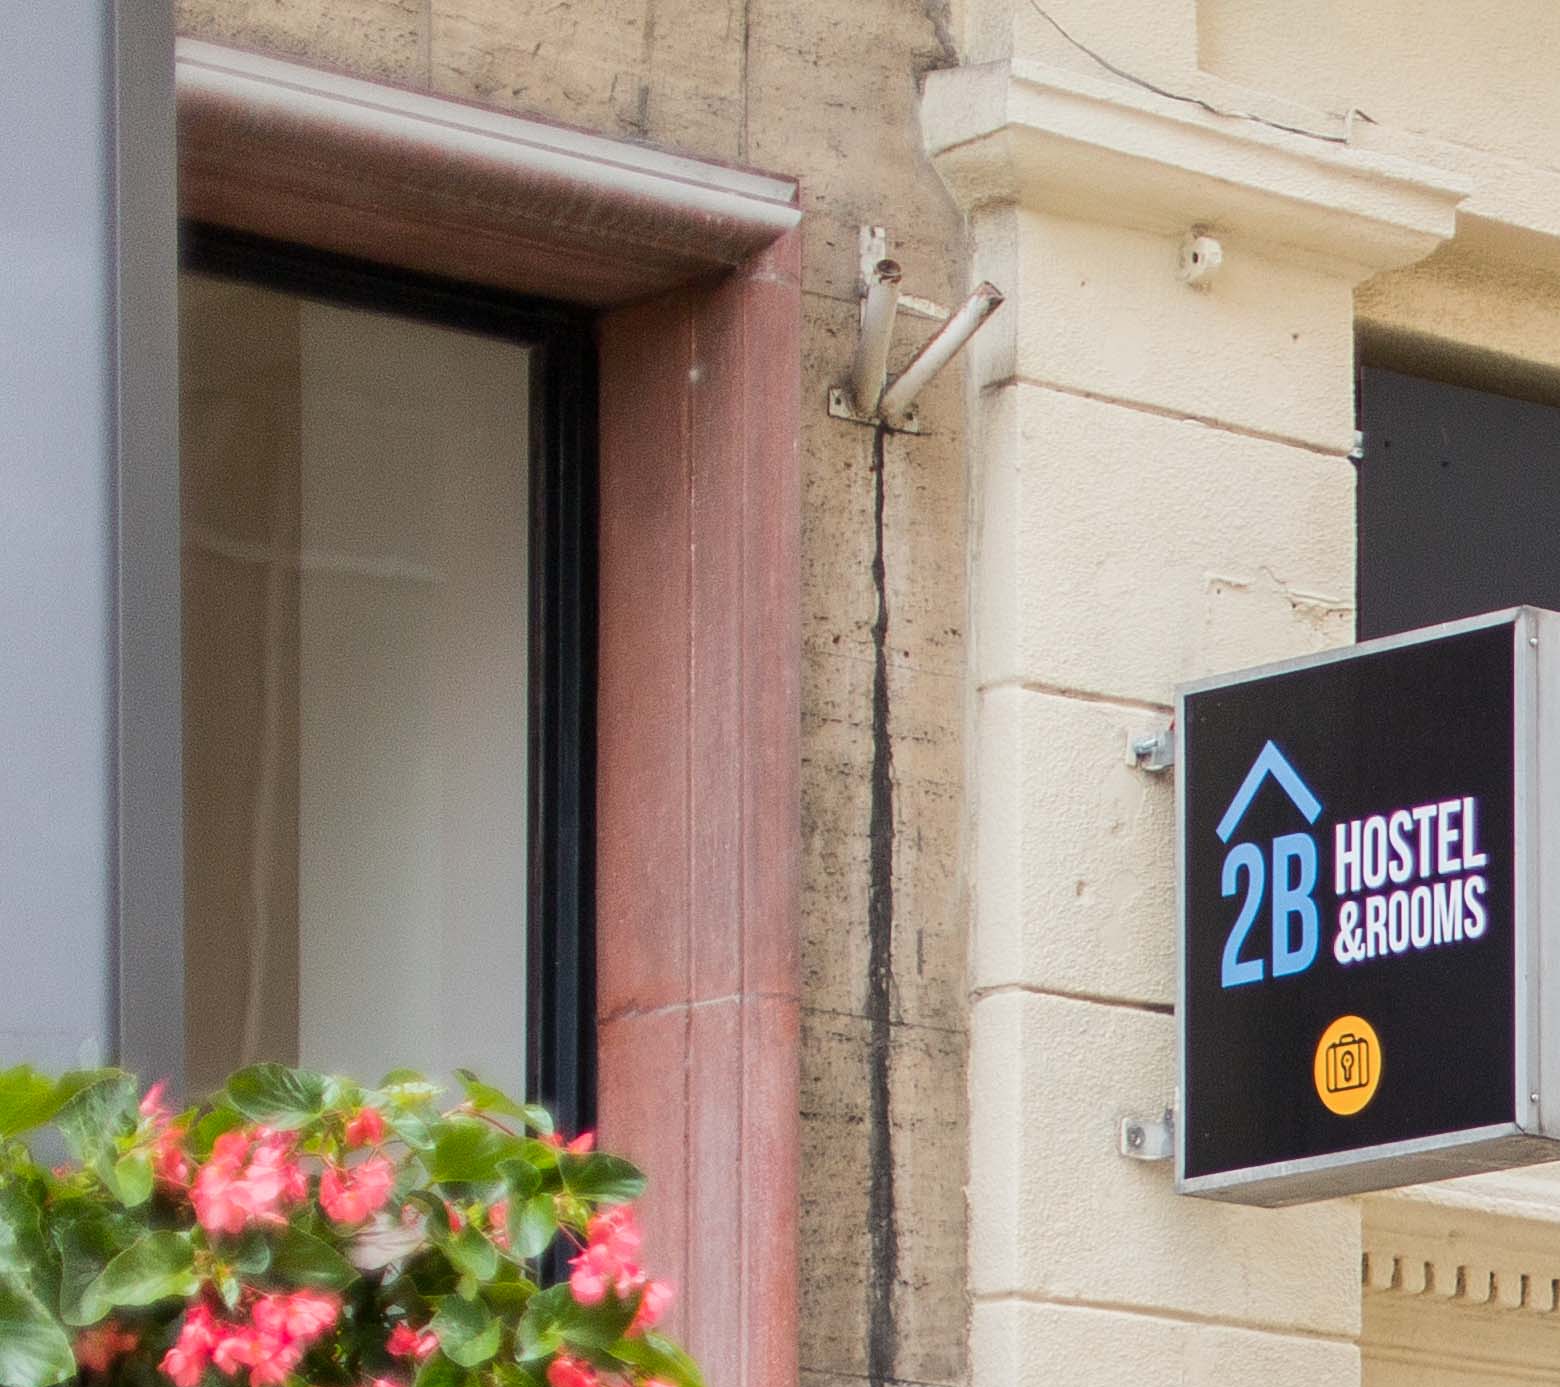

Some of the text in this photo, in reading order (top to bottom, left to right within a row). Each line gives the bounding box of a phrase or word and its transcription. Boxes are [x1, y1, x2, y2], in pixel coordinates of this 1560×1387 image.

[1221, 796, 1489, 988] 2B HOSTEL
[1333, 875, 1489, 966] &ROOMS
